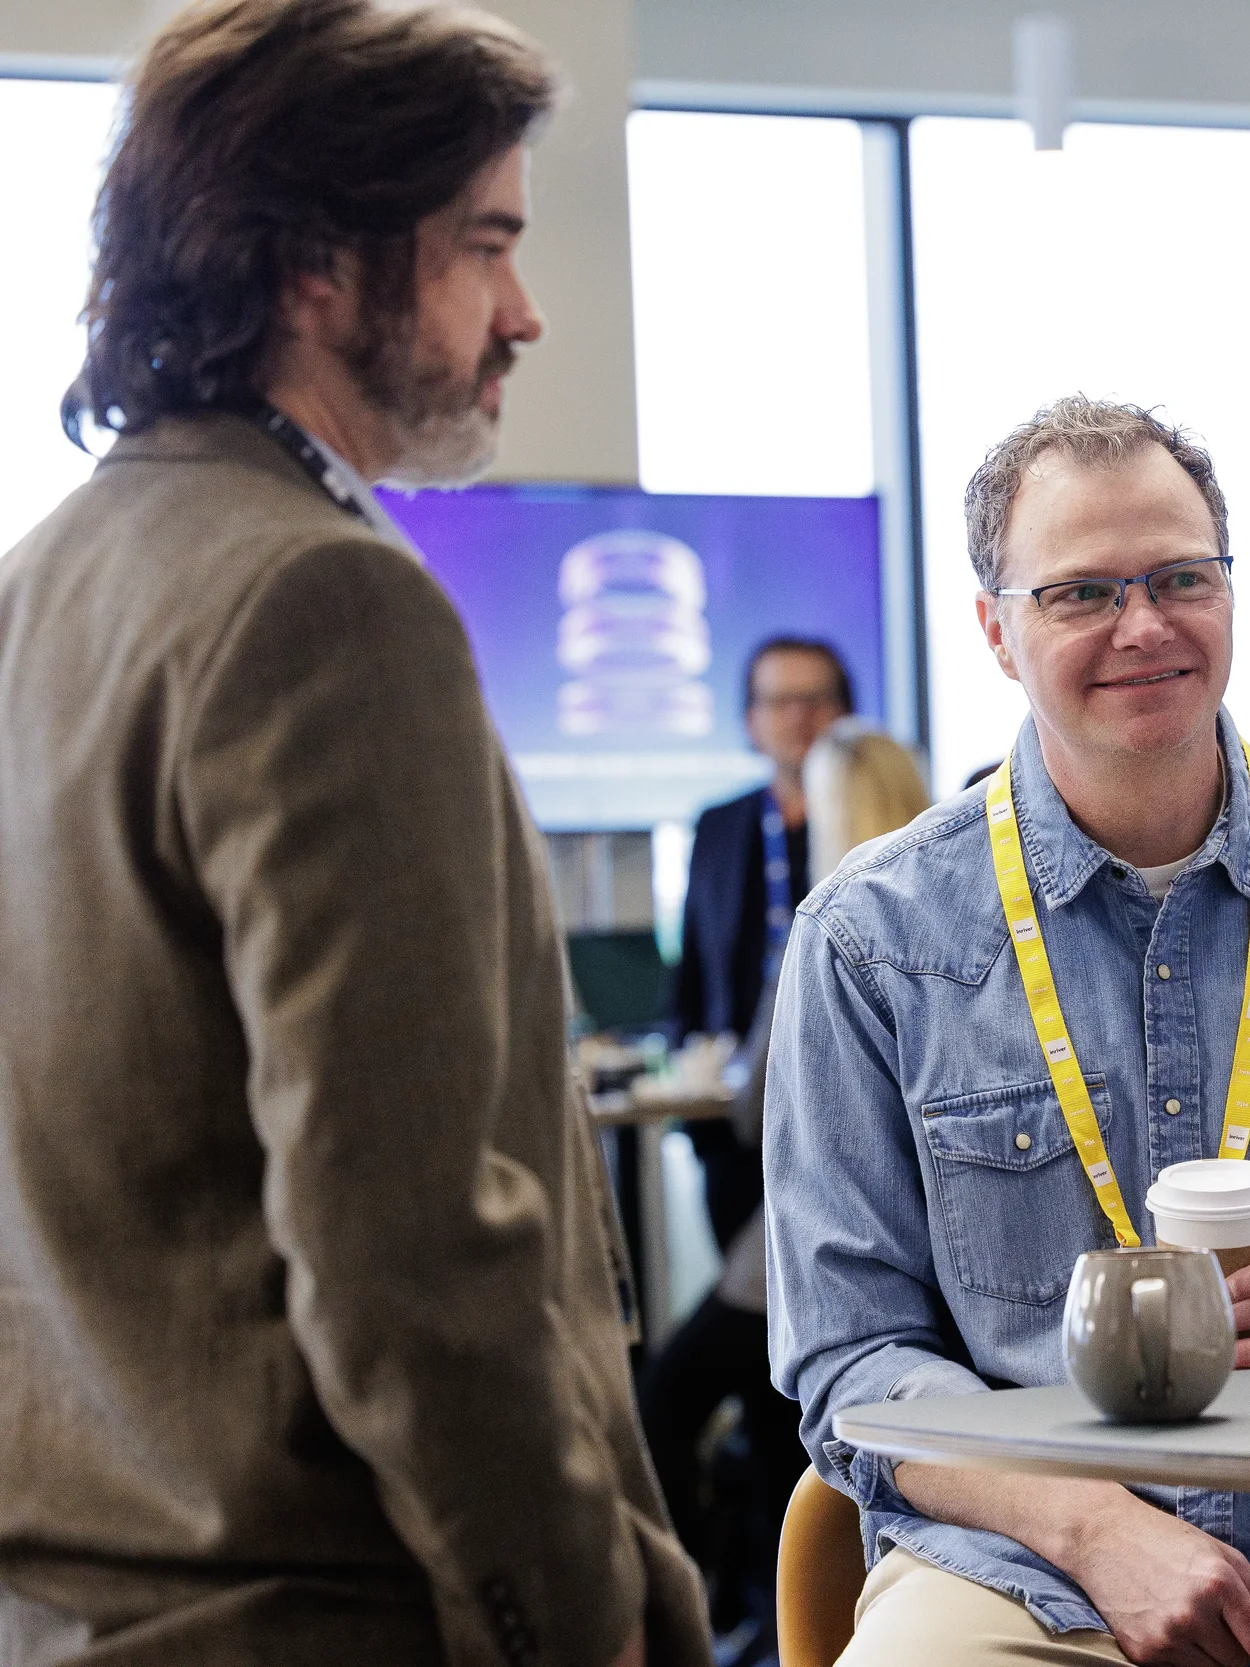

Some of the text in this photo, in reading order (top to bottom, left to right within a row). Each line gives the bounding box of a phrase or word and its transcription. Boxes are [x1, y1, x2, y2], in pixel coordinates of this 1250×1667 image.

[1016, 925, 1033, 934] inriver
[1049, 1045, 1066, 1055] inriver
[1236, 1100, 1249, 1108] PIM
[1229, 1133, 1245, 1142] inriver
